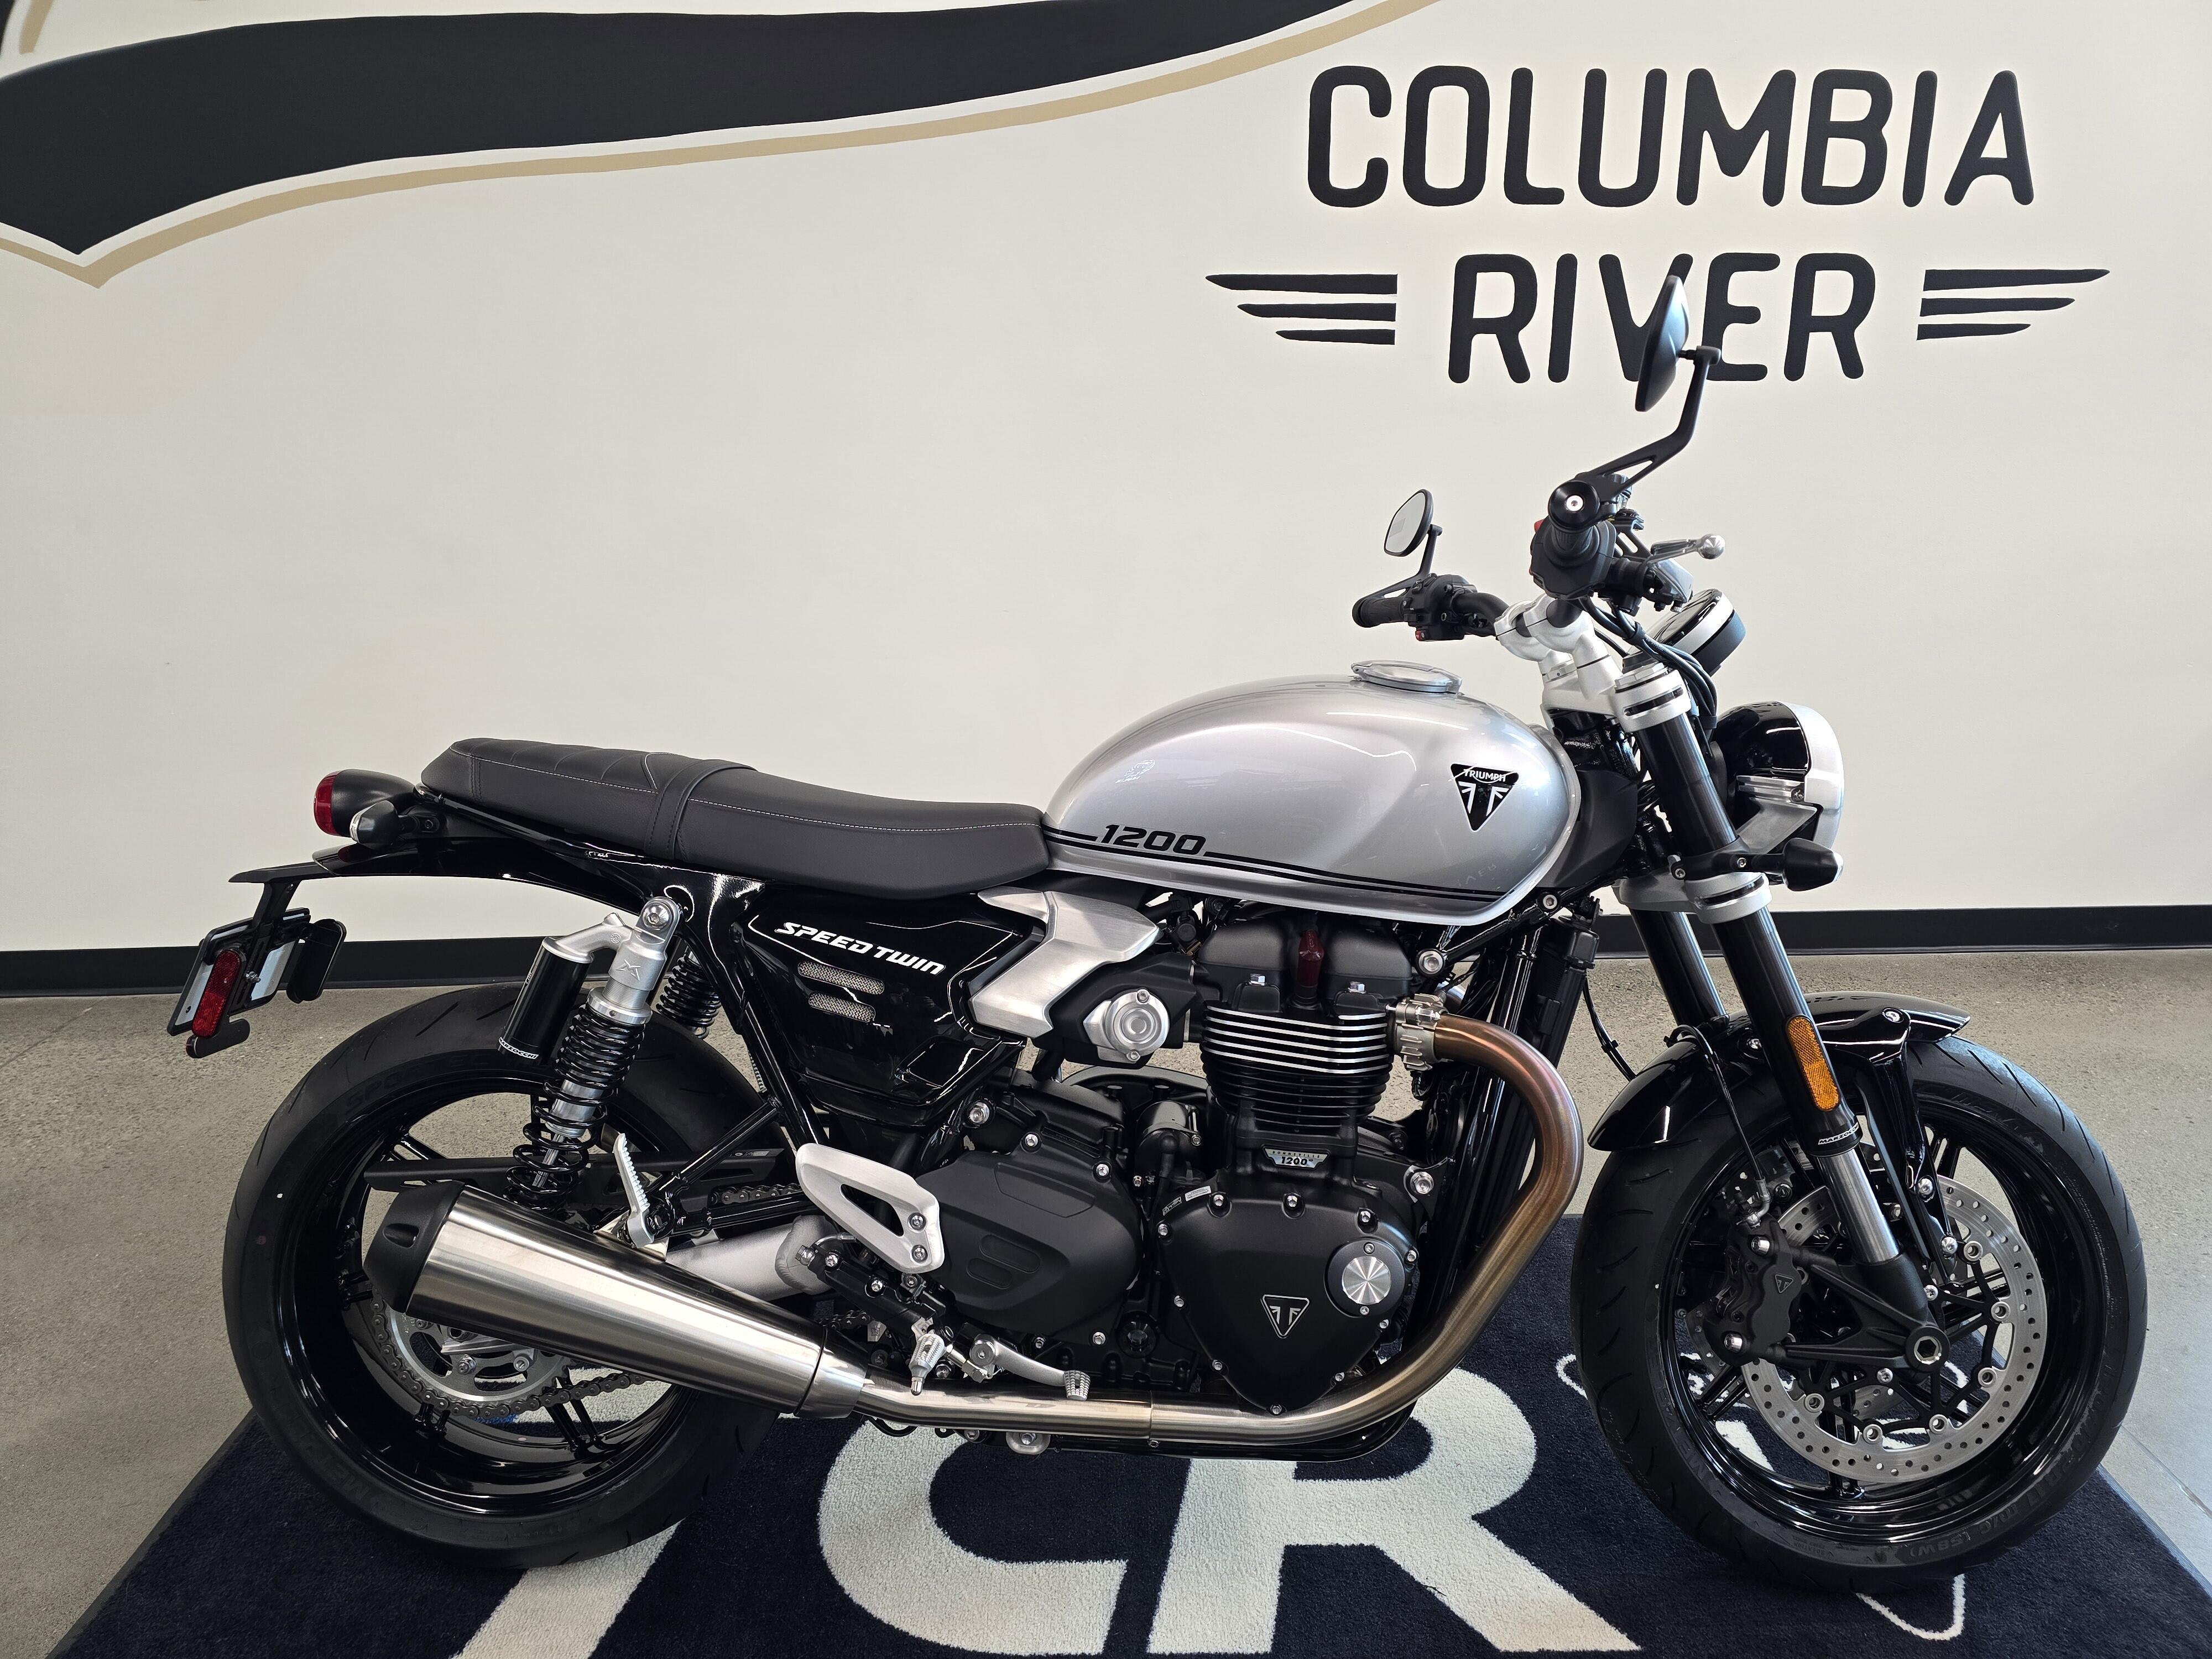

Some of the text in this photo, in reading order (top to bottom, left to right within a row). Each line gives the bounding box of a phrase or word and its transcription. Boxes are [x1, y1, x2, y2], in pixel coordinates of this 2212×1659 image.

[1308, 66, 2033, 207] COLUMBIA
[1448, 253, 1875, 383] RIVER
[1463, 769, 1506, 782] TRIUMPH
[1101, 825, 1206, 855] 1200
[775, 922, 945, 975] SPEED TWIN
[499, 1037, 537, 1059] MARZOCCHI
[1281, 1156, 1308, 1165] 1200
